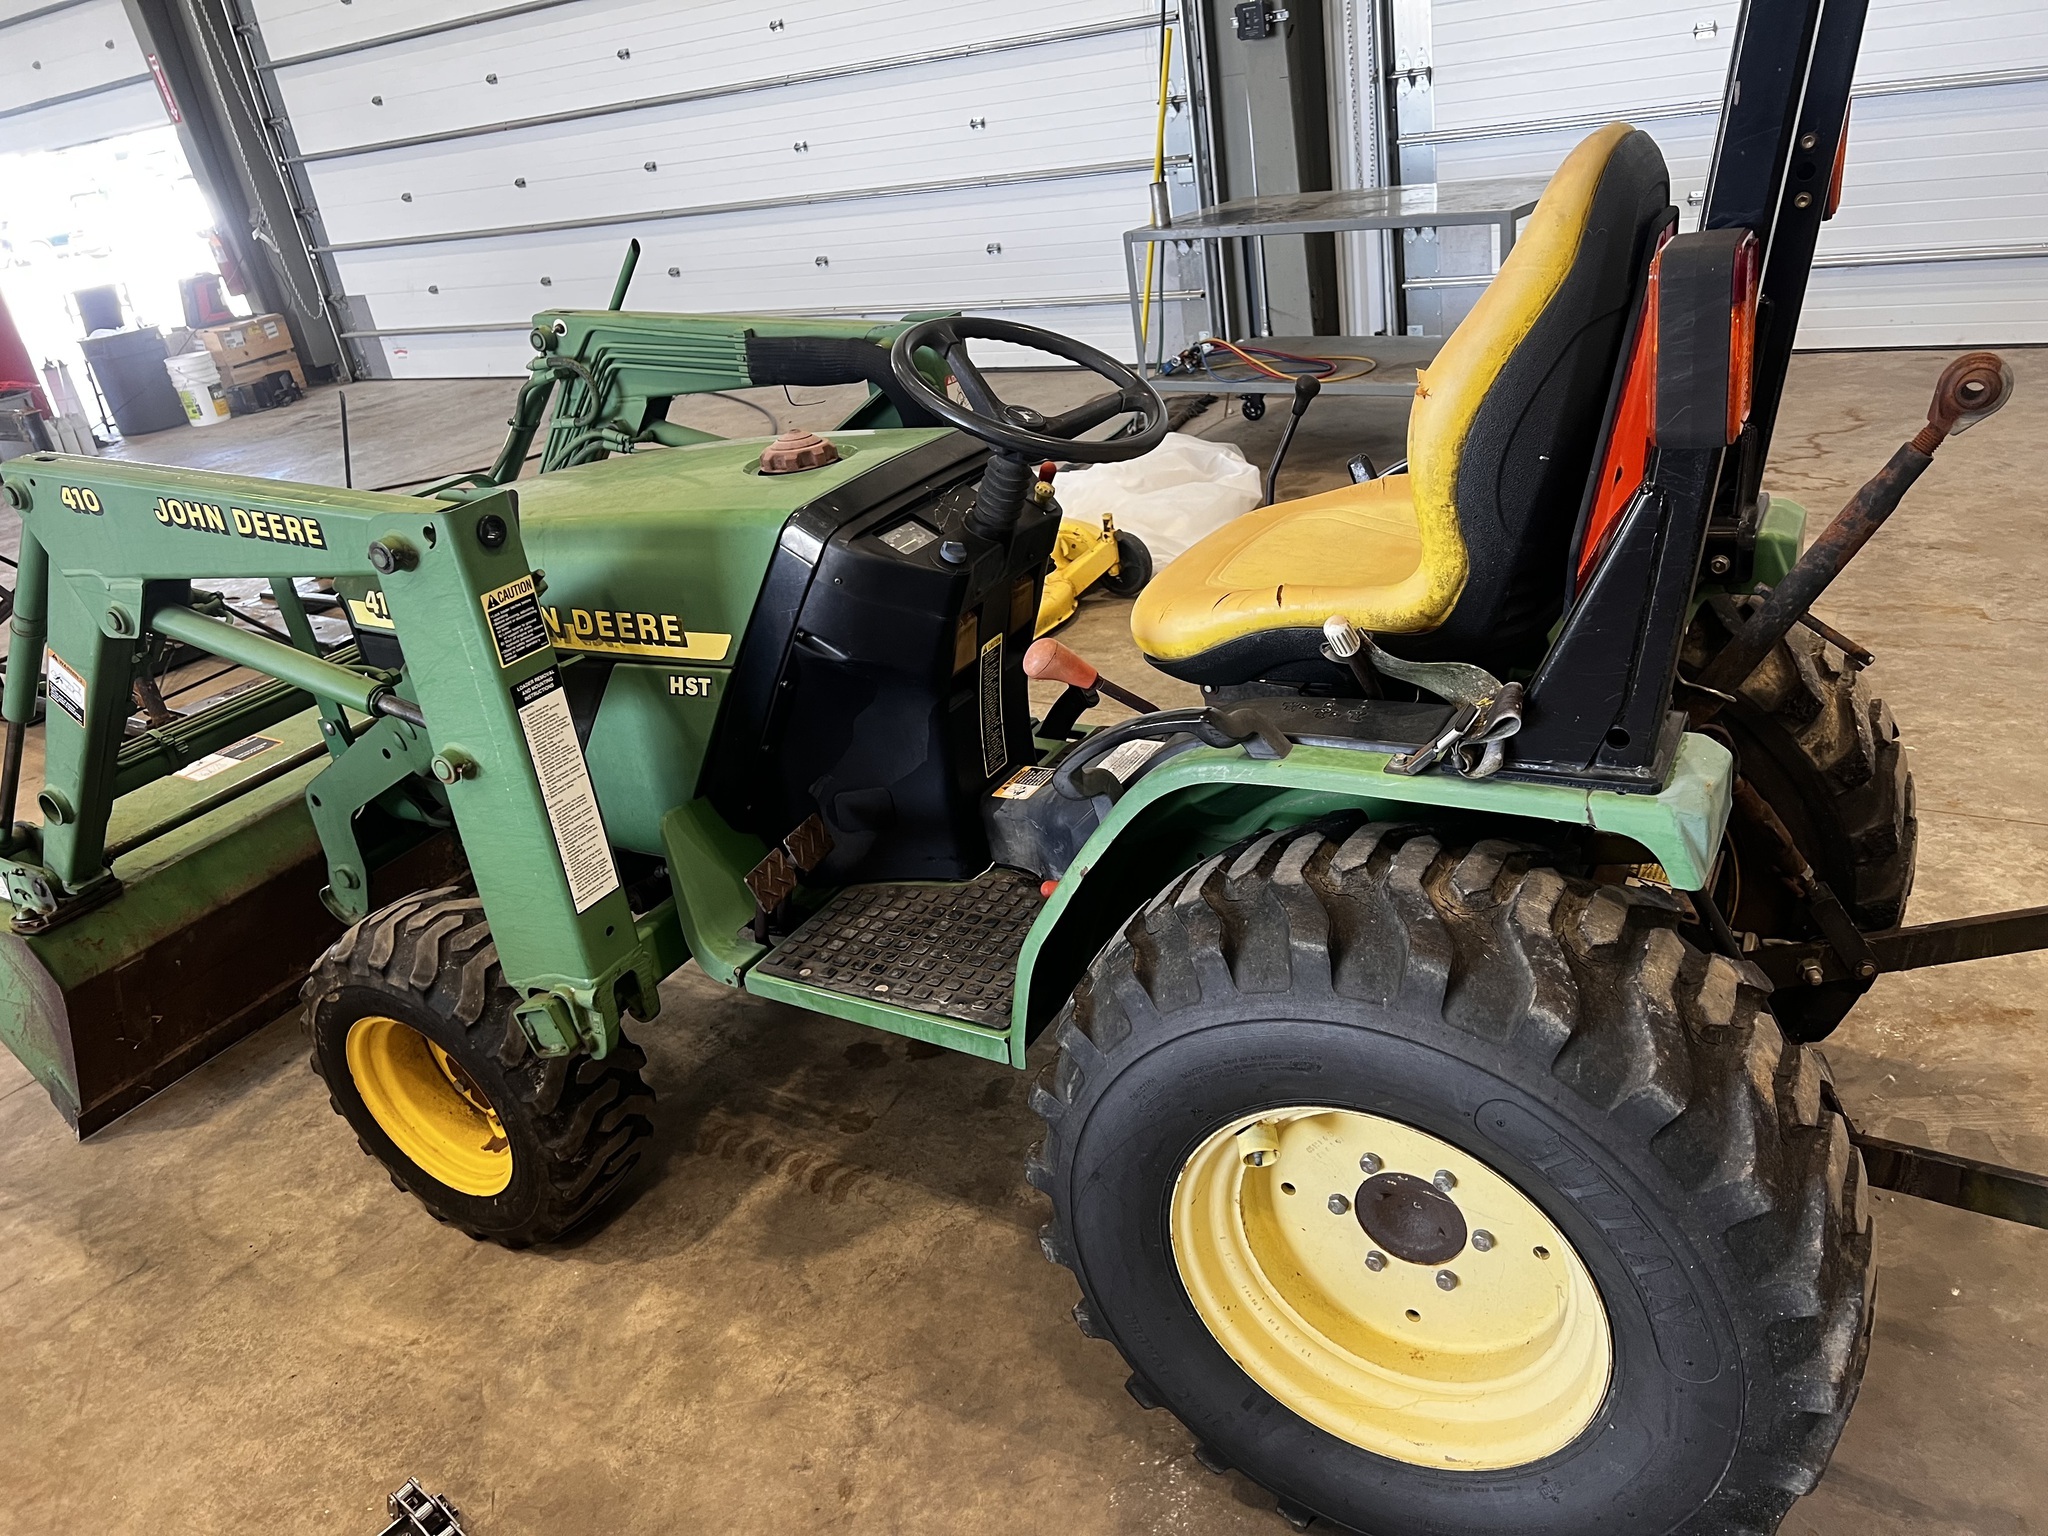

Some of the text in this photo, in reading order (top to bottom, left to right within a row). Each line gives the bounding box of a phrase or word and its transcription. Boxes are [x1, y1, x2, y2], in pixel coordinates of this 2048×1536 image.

[61, 486, 102, 514] 410
[154, 497, 326, 548] JOHN DEERE
[365, 590, 390, 617] 41
[497, 579, 533, 603] CAUTION
[571, 608, 685, 645] DEERE
[669, 676, 711, 696] HST
[1530, 1134, 1708, 1332] TITAN
